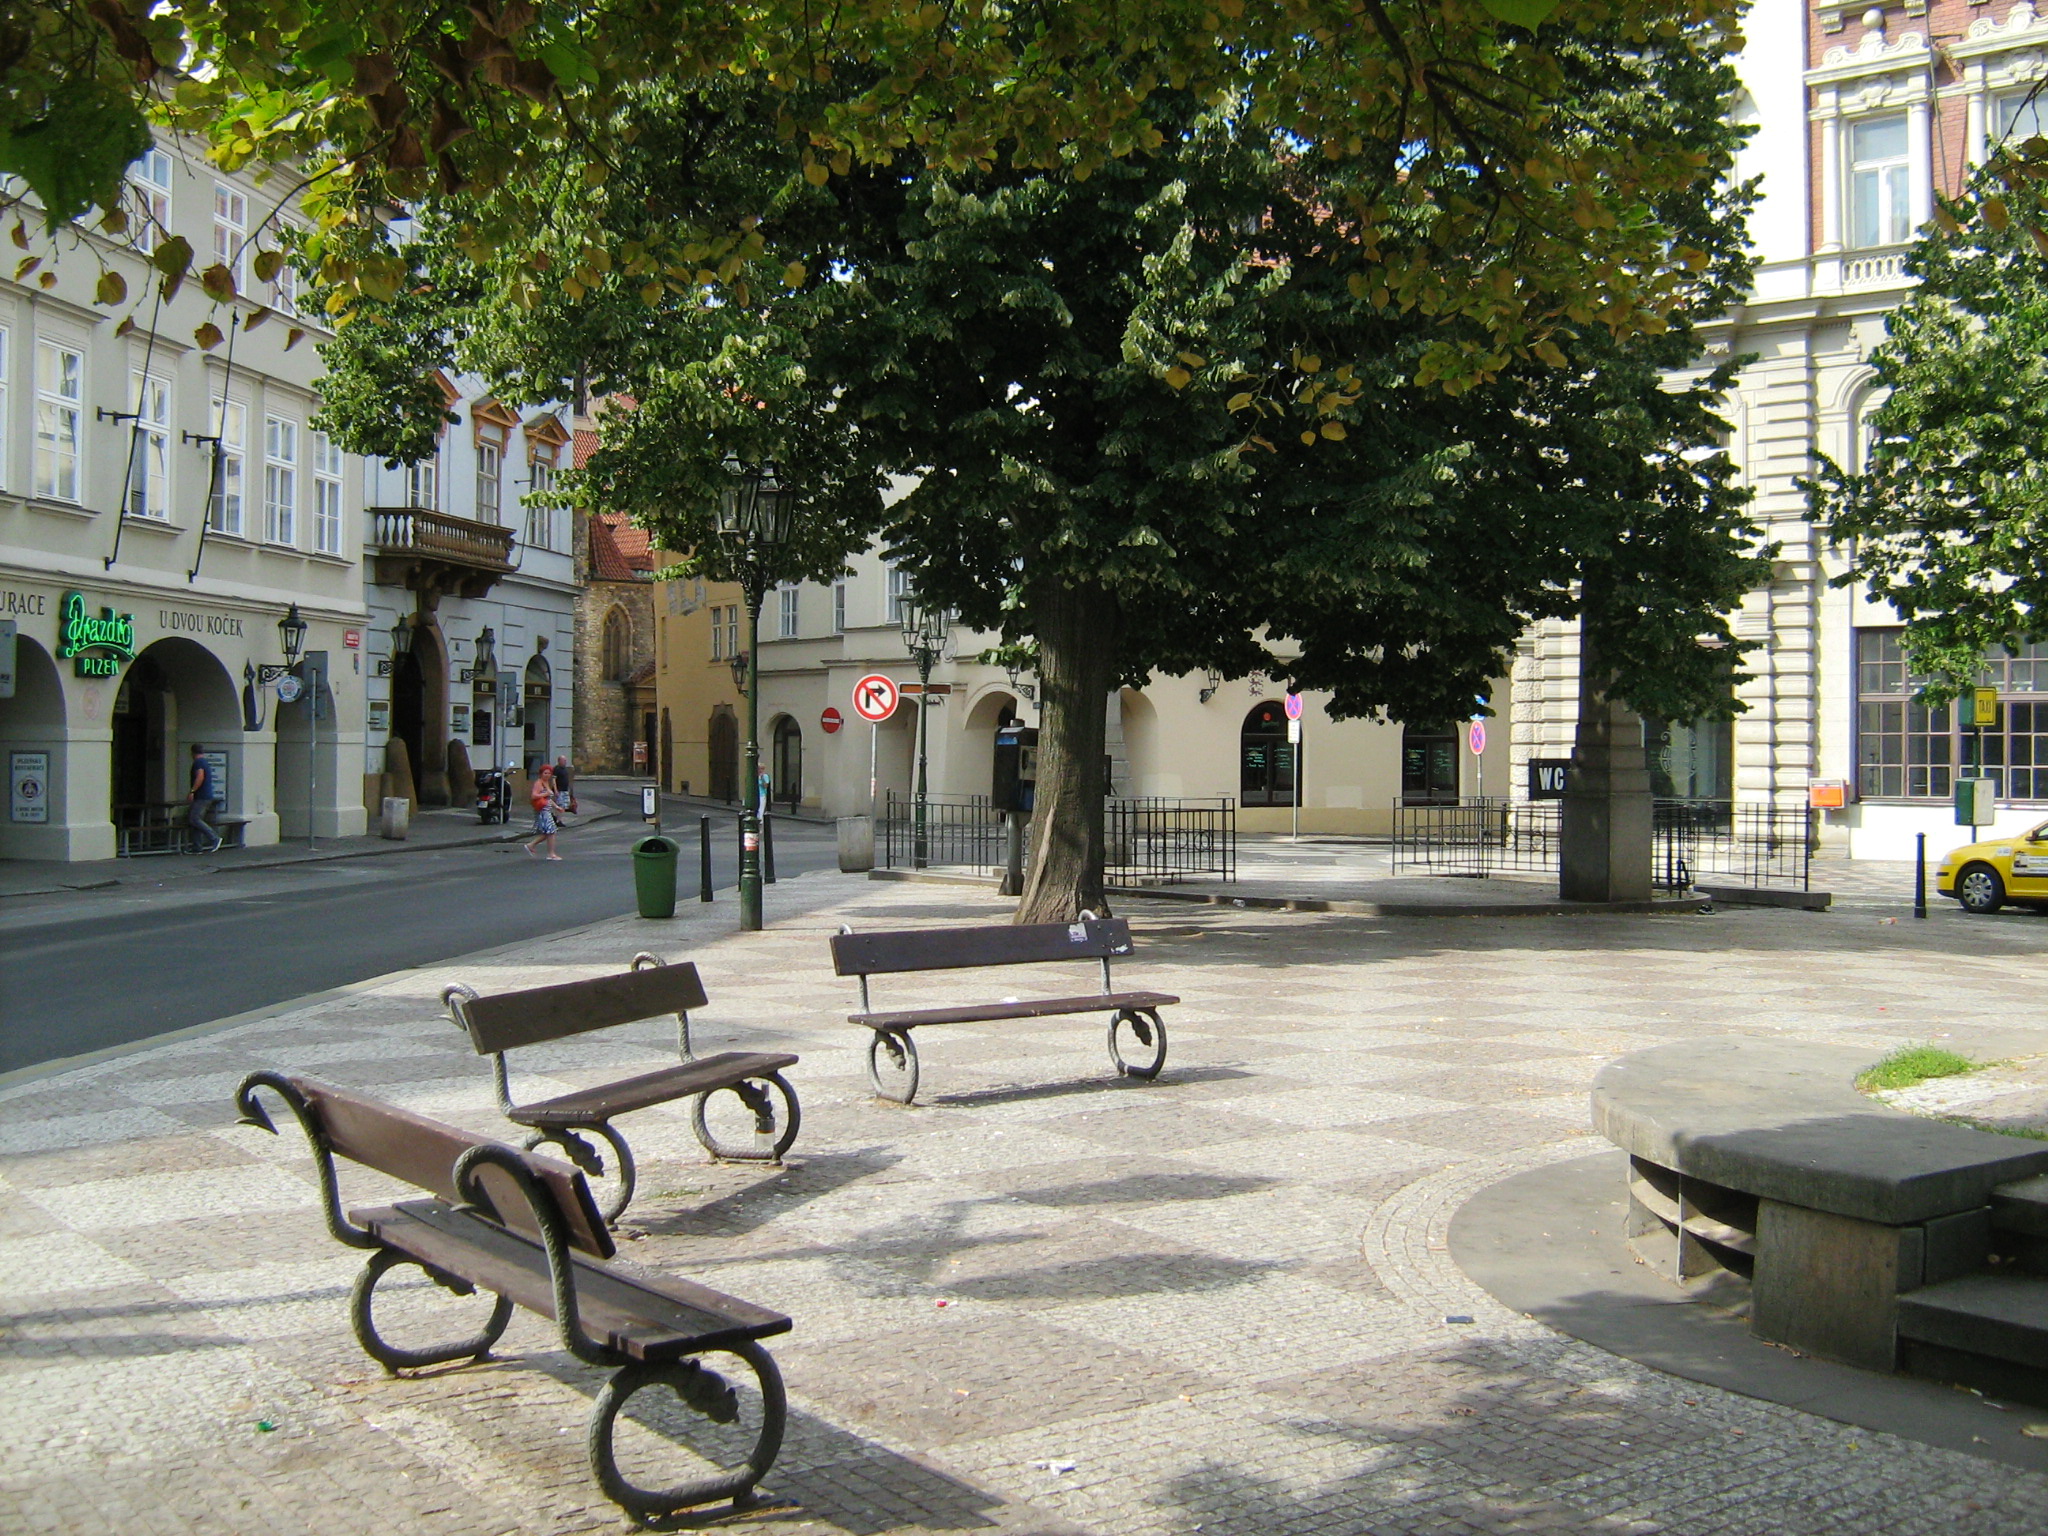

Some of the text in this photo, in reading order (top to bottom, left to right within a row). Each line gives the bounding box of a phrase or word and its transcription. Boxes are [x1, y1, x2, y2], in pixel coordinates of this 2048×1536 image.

[66, 594, 135, 658] Prazdroj
[160, 610, 243, 638] U DVOU KOČEK
[84, 654, 119, 676] PLZEŇ
[1539, 767, 1564, 790] WC
